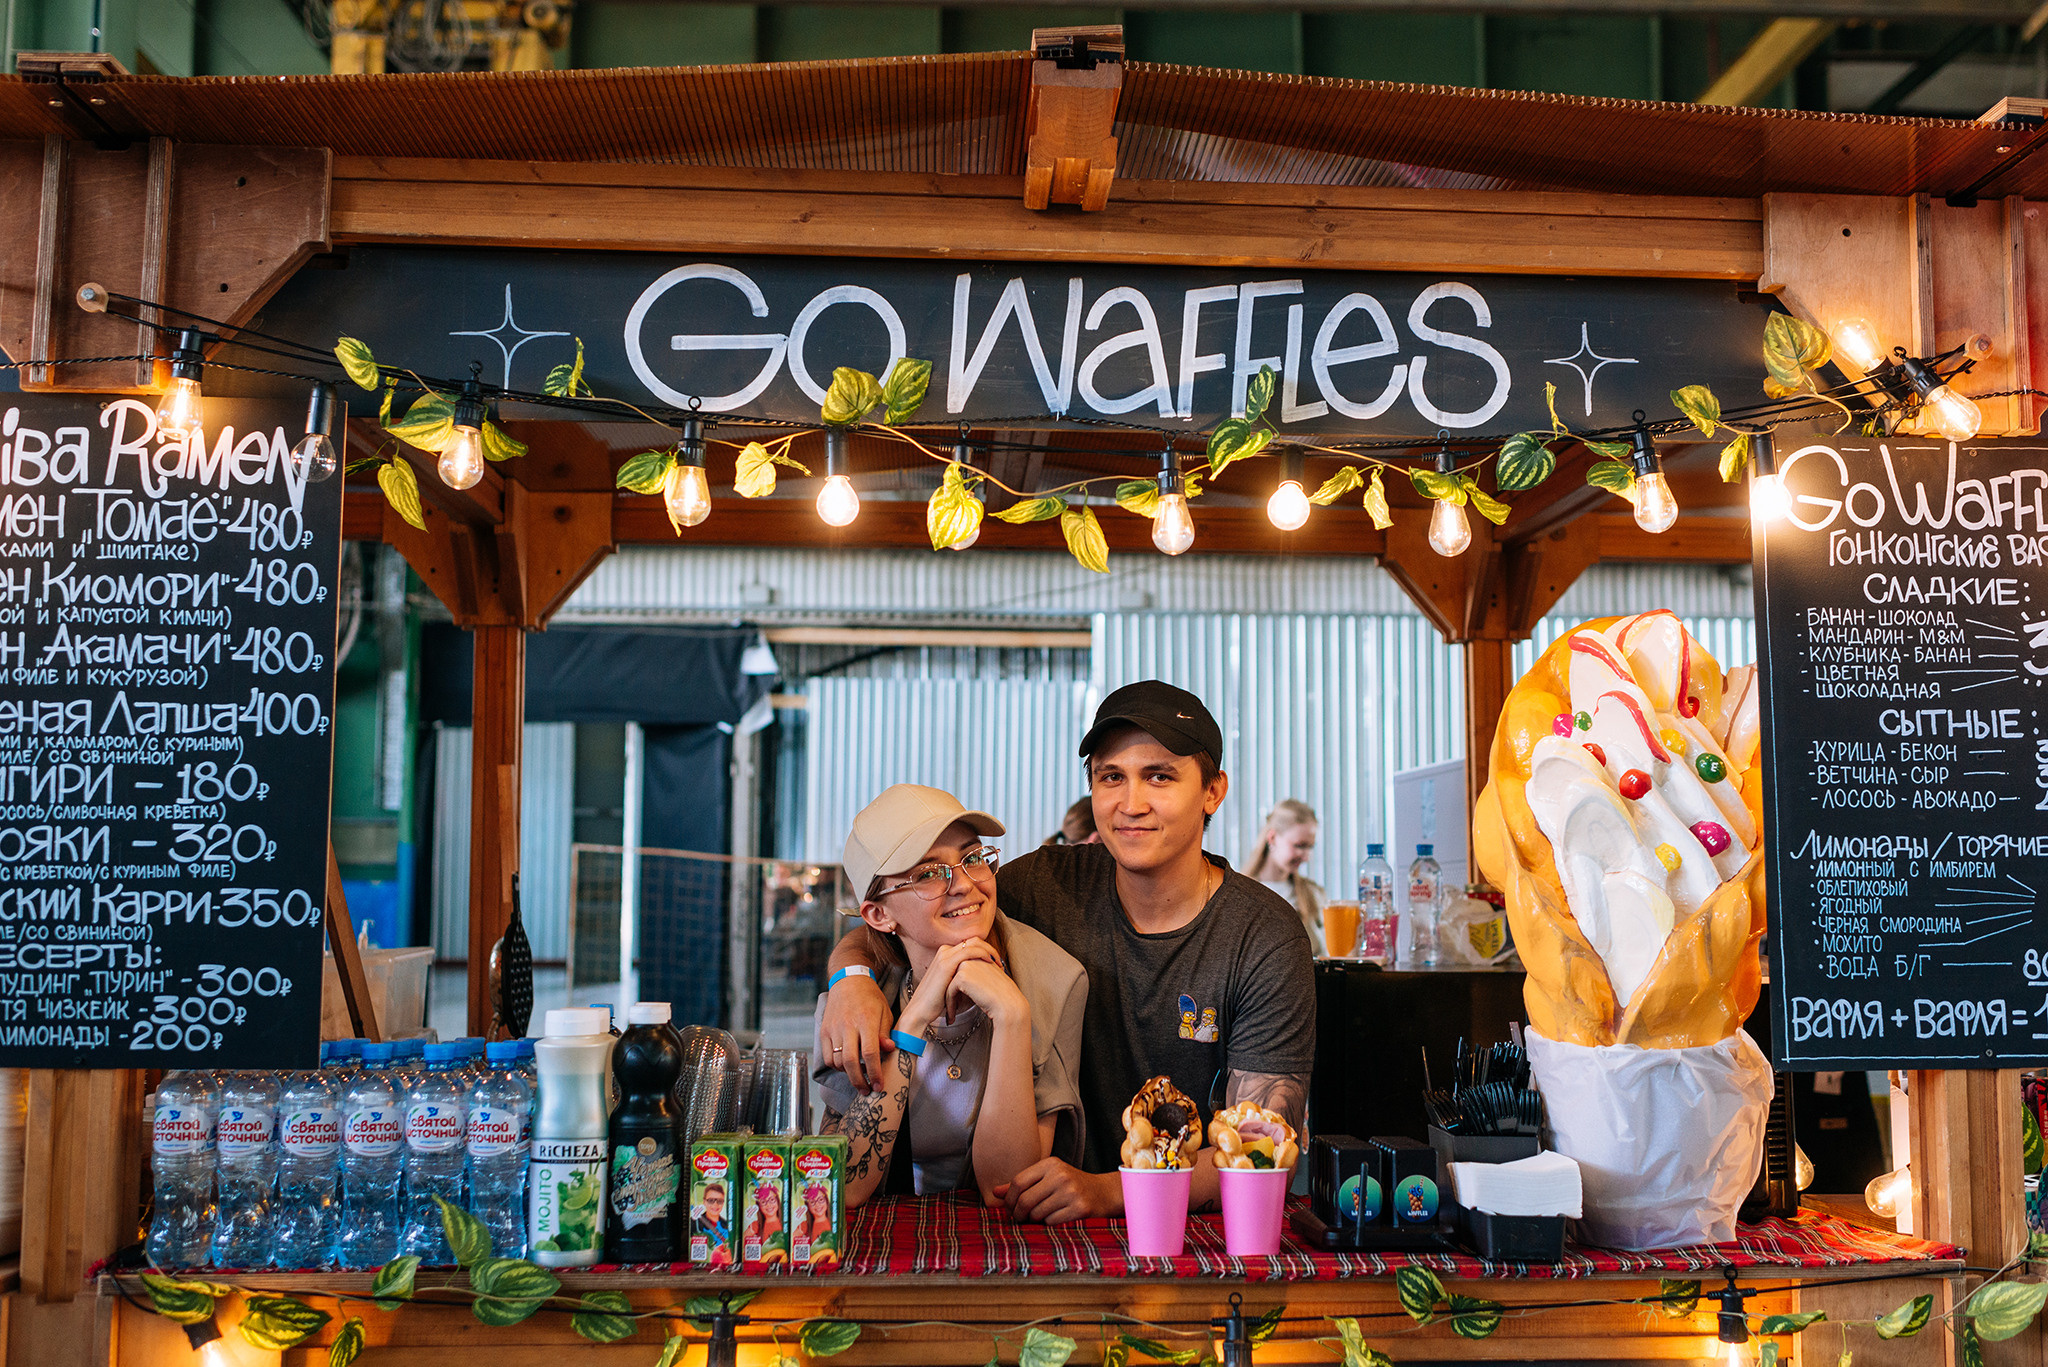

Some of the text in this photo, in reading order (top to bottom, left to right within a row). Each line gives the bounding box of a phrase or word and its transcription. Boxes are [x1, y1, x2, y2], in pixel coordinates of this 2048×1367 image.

[625, 263, 907, 411] Go
[1778, 444, 1886, 532] Go
[72, 542, 86, 559] И
[37, 608, 50, 625] И
[57, 604, 150, 627] КАПУСТОЙ
[12, 667, 59, 687] ФИЛЕ
[66, 668, 79, 686] И
[1815, 664, 1900, 684] ЦВЕТНАЯ
[1815, 681, 1942, 702] ШОКОЛАДНАЯ
[27, 736, 40, 750] И
[48, 749, 72, 764] СО
[79, 749, 175, 766] СВИНИНОЙ
[113, 863, 181, 880] КУРИНЫМ
[1909, 861, 1919, 878] С
[1929, 861, 1997, 879] ИМБИРЕМ
[1879, 915, 1963, 934] СМОРОДИНА
[1822, 935, 1883, 953] МОХИТО
[1826, 954, 1880, 980] ВОДА
[37, 995, 130, 1021] ЧИЗКЕЙК
[154, 1131, 208, 1142] сточник
[217, 1131, 270, 1143] сточник
[466, 1133, 517, 1144] сточник
[538, 1168, 553, 1233] MOJITO
